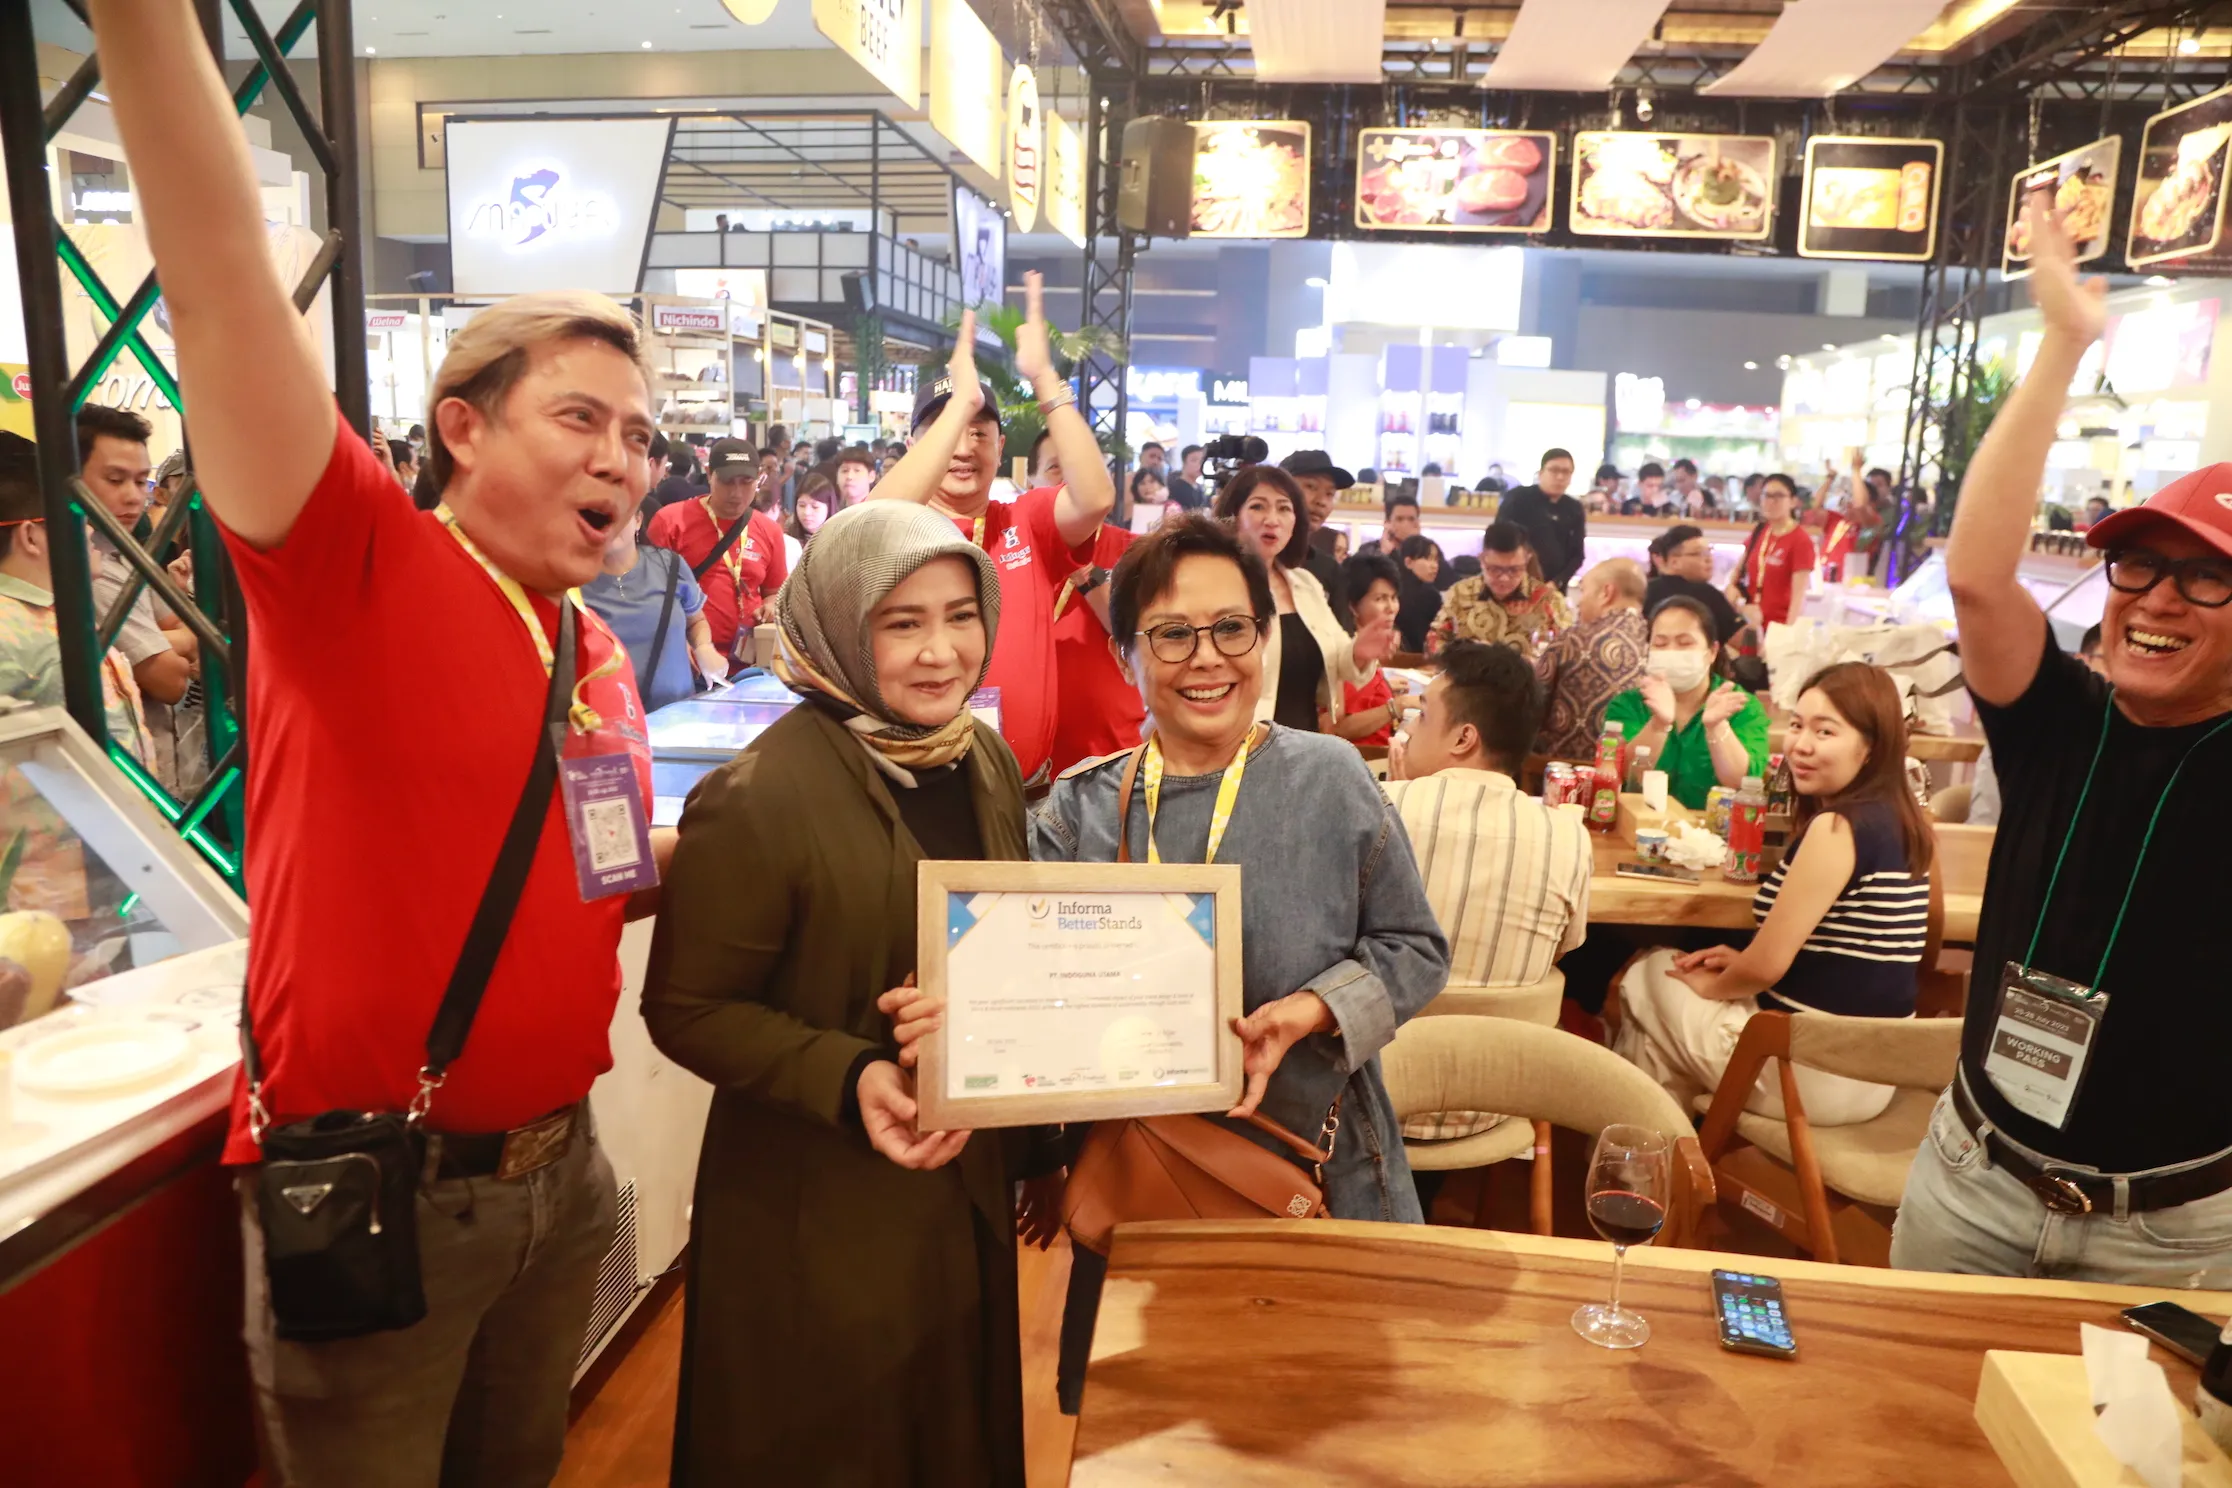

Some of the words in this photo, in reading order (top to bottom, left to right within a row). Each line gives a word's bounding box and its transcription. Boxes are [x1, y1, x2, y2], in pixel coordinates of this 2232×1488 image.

[860, 3, 889, 65] BEEF
[662, 313, 716, 327] Nichindo
[601, 874, 623, 885] SCAN
[1057, 901, 1112, 914] Informa
[1057, 916, 1142, 930] BetterStands
[2006, 1036, 2061, 1063] WORKING
[2016, 1051, 2046, 1068] PASS
